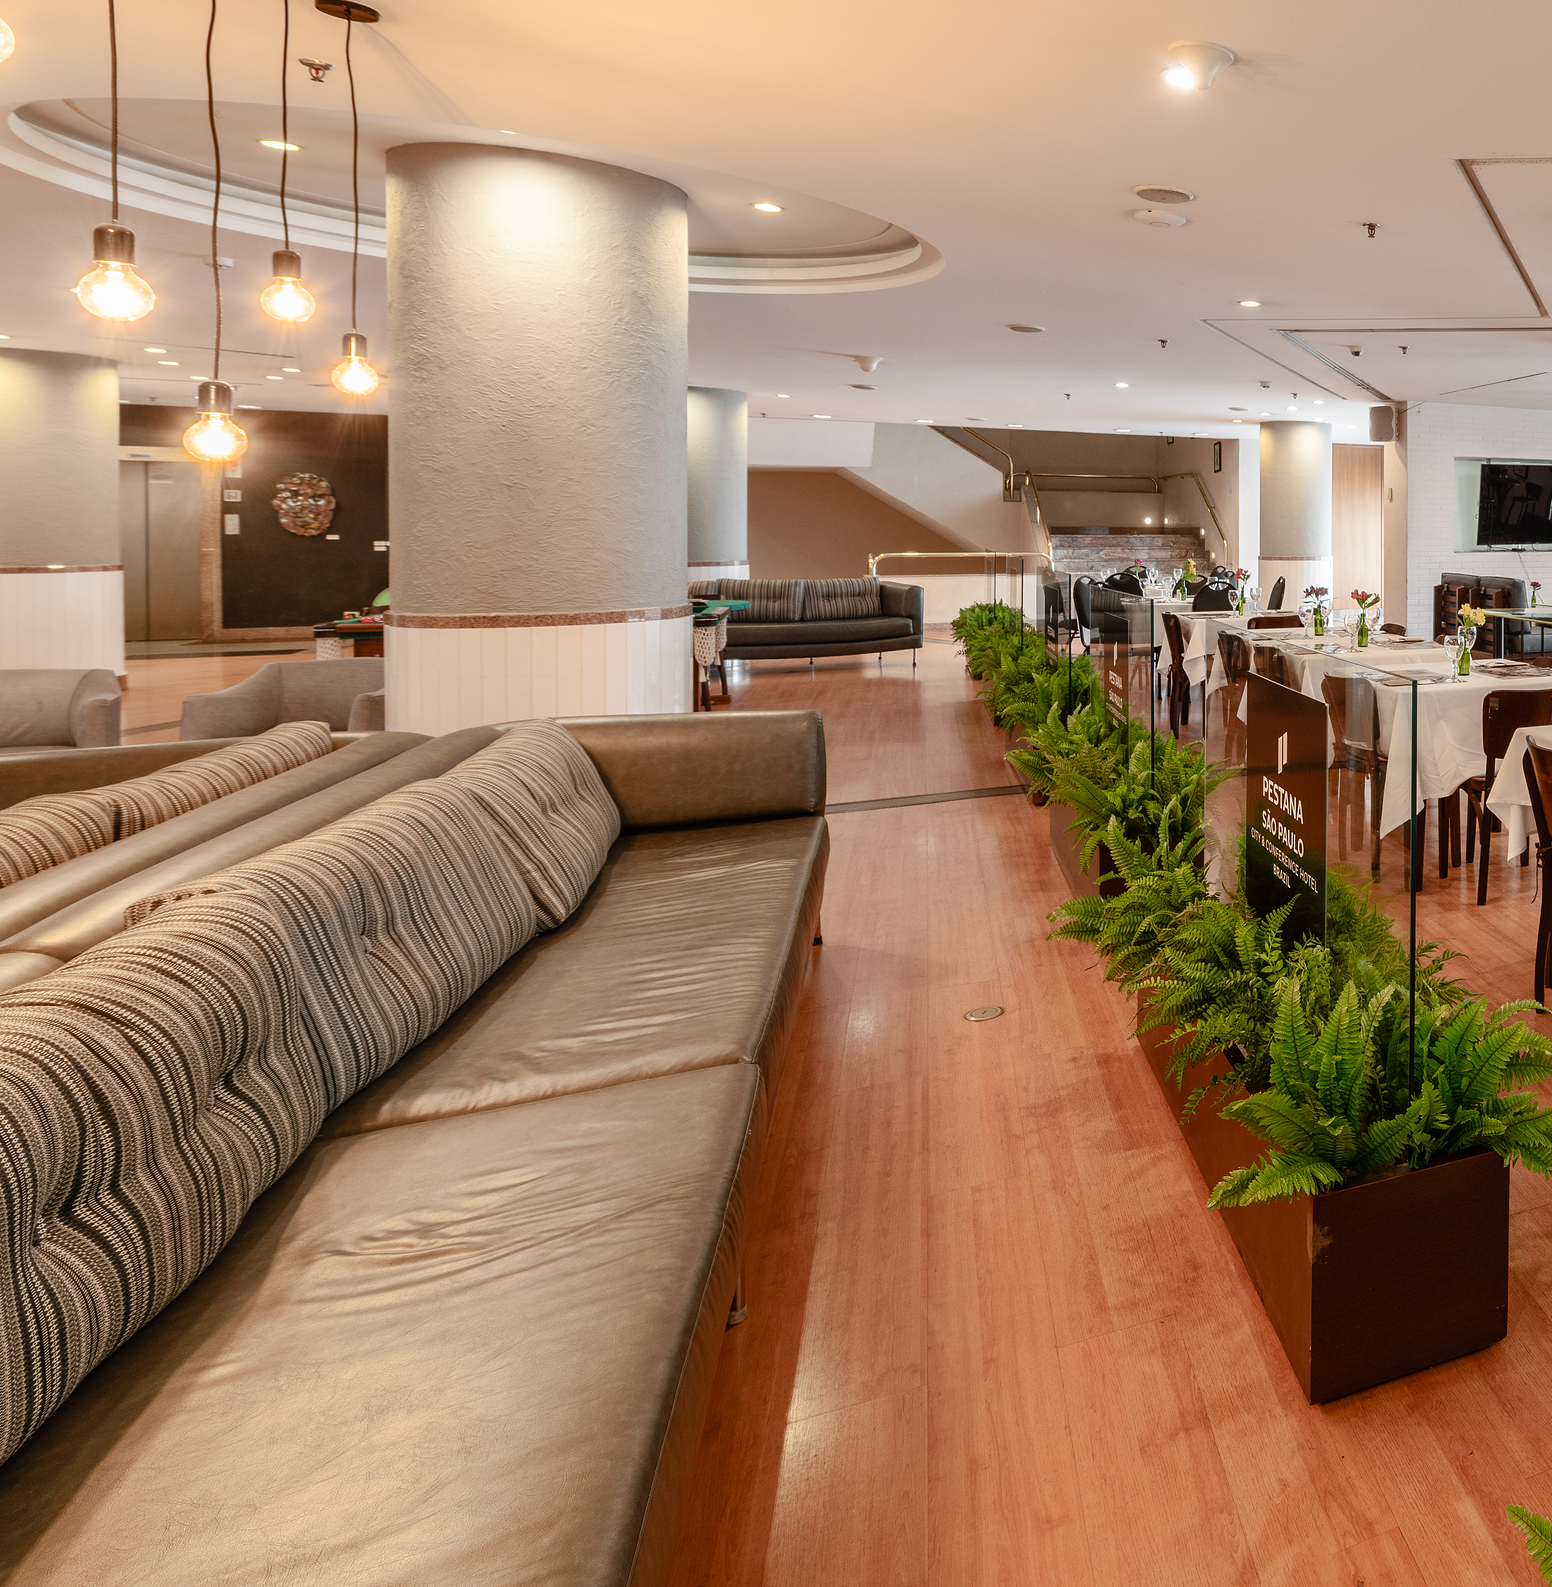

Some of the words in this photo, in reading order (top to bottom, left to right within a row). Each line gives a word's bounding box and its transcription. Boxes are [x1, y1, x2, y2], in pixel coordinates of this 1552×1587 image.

[1262, 775, 1304, 825] PESTANA
[1262, 808, 1277, 836] SÃO
[1277, 821, 1305, 858] PAULO
[1250, 827, 1261, 843] CITY
[1265, 839, 1300, 877] CONFERENCE
[1299, 867, 1319, 894] HOTEL
[1272, 863, 1291, 889] BRAZIL
